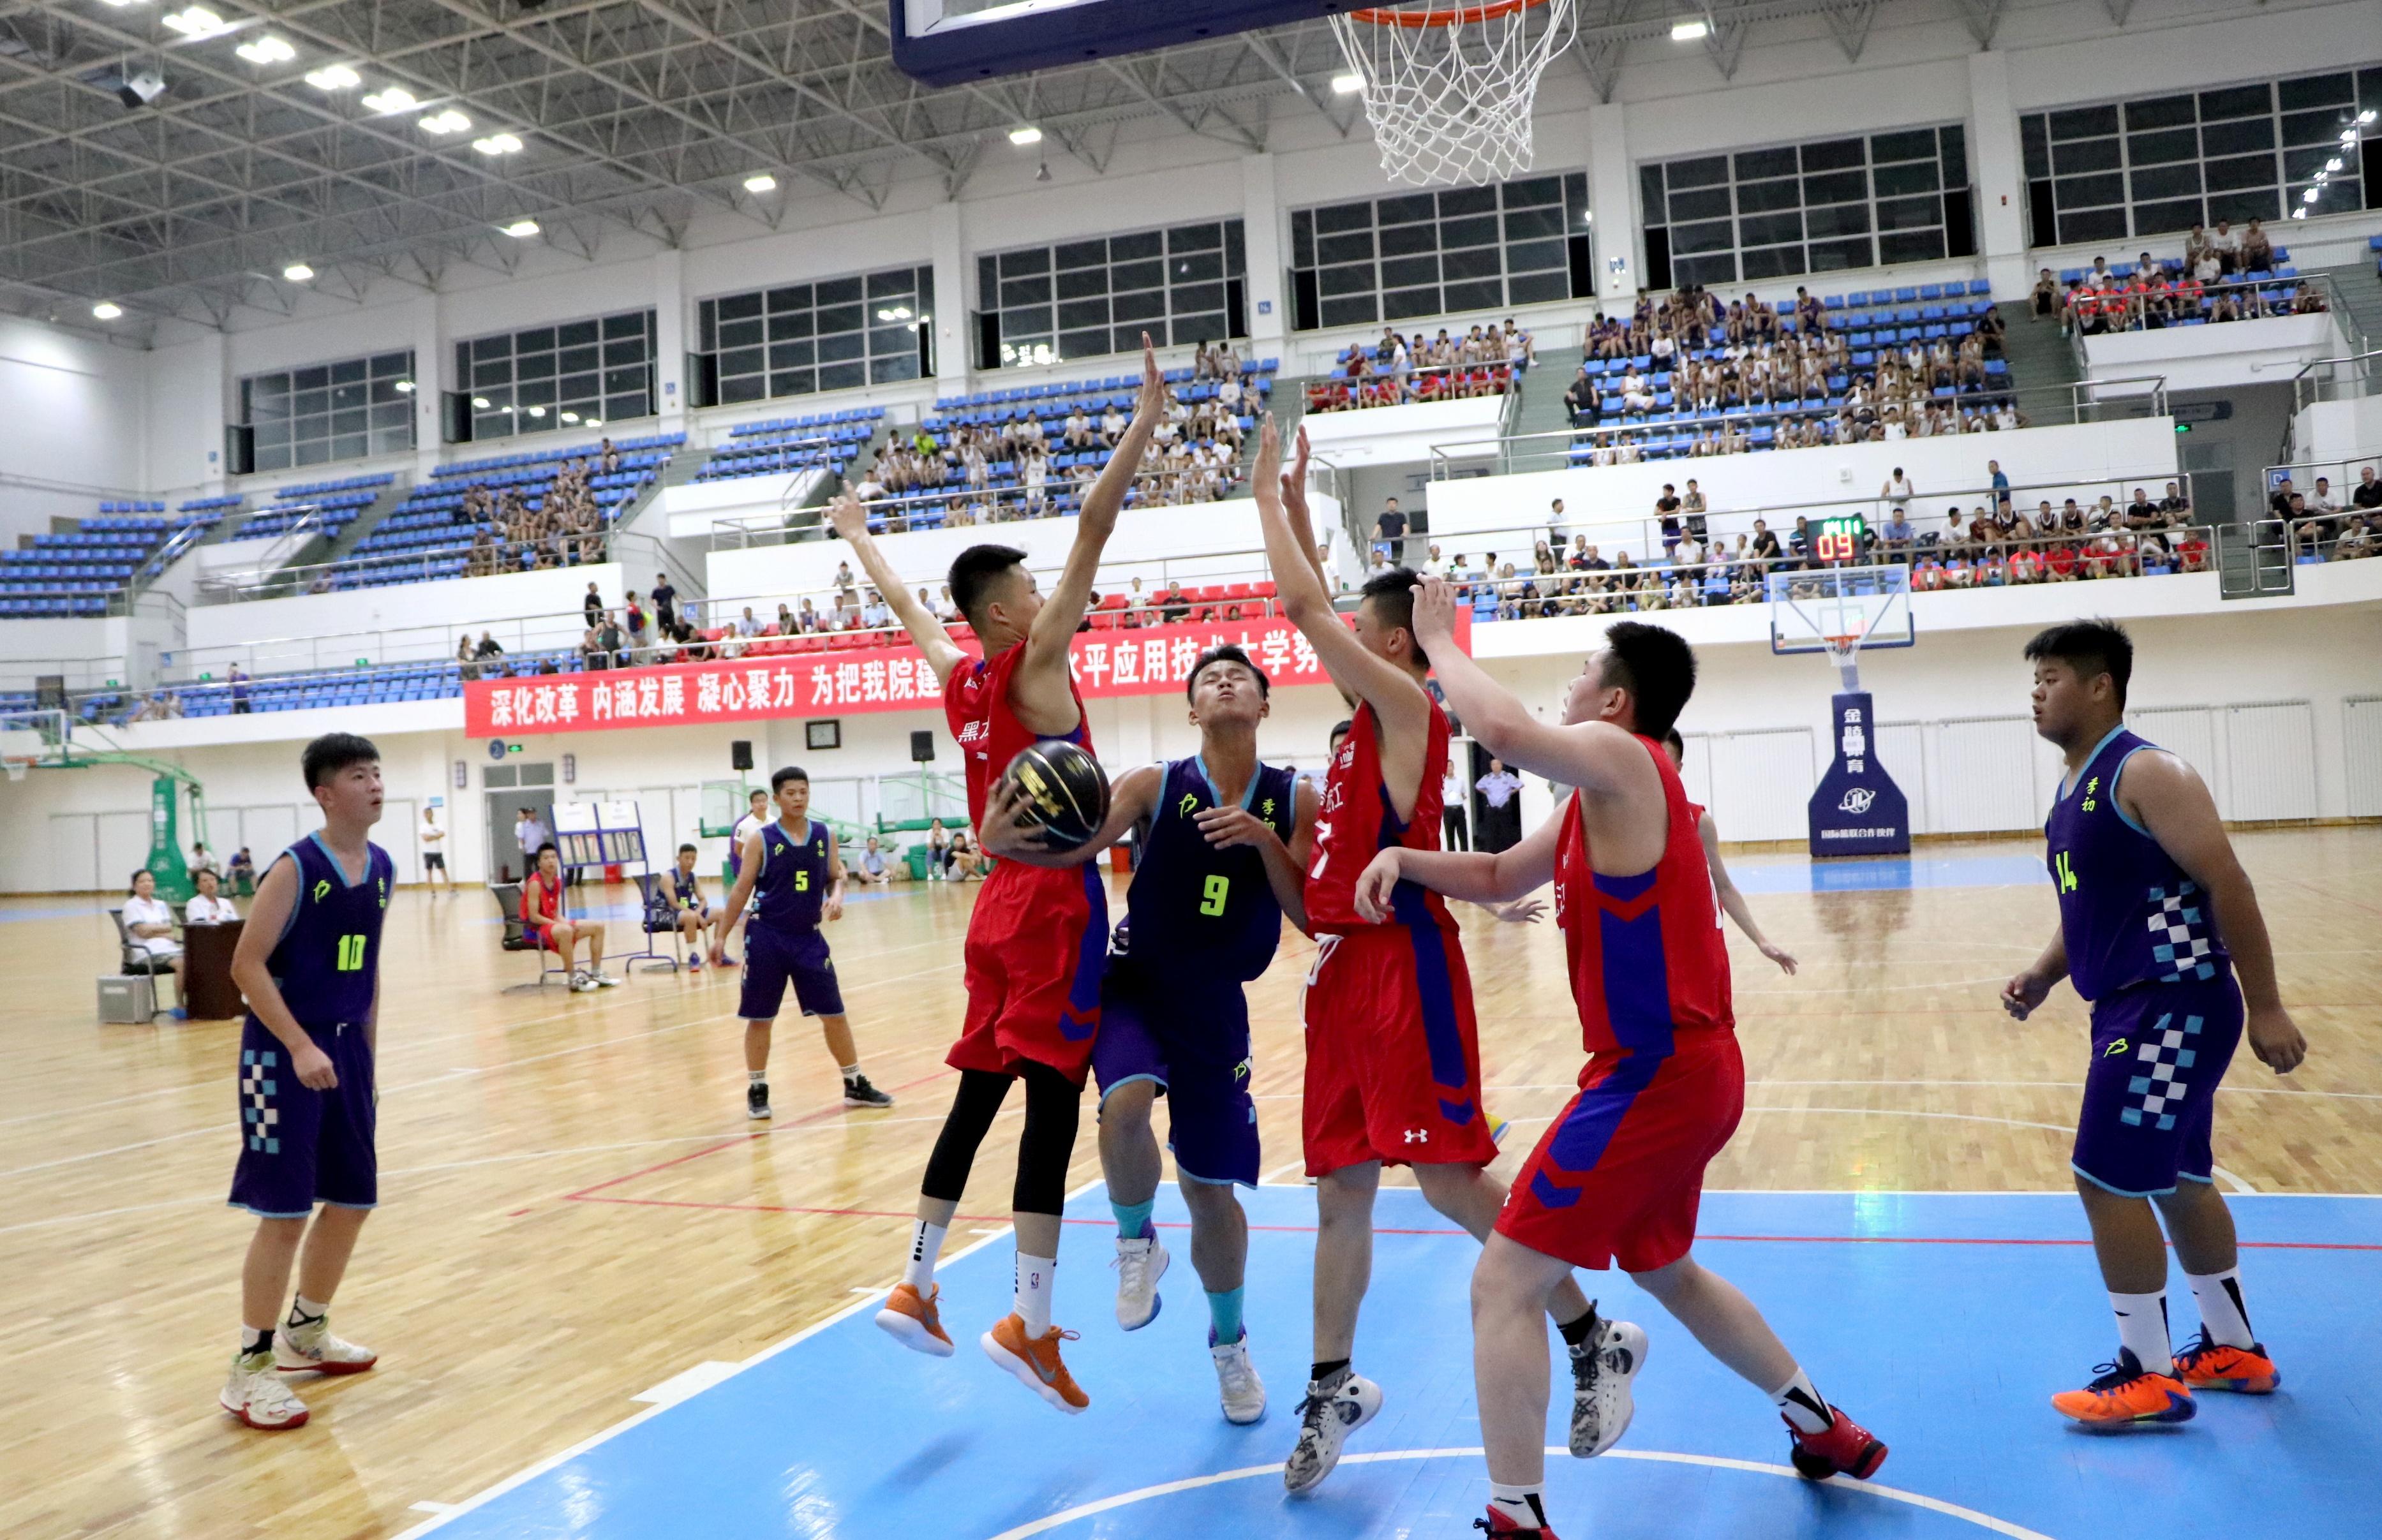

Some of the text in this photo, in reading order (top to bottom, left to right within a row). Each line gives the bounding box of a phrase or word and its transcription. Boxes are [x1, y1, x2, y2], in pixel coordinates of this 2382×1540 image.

[1817, 533, 1853, 559] 09
[491, 683, 579, 726] 深化改革
[593, 676, 684, 720] 内涵发展
[697, 667, 794, 712] 凝心聚力
[811, 657, 941, 705] 为把我院建
[795, 870, 808, 891] 5
[2056, 851, 2078, 894] 14
[1200, 875, 1230, 917] 9
[338, 935, 367, 971] 10
